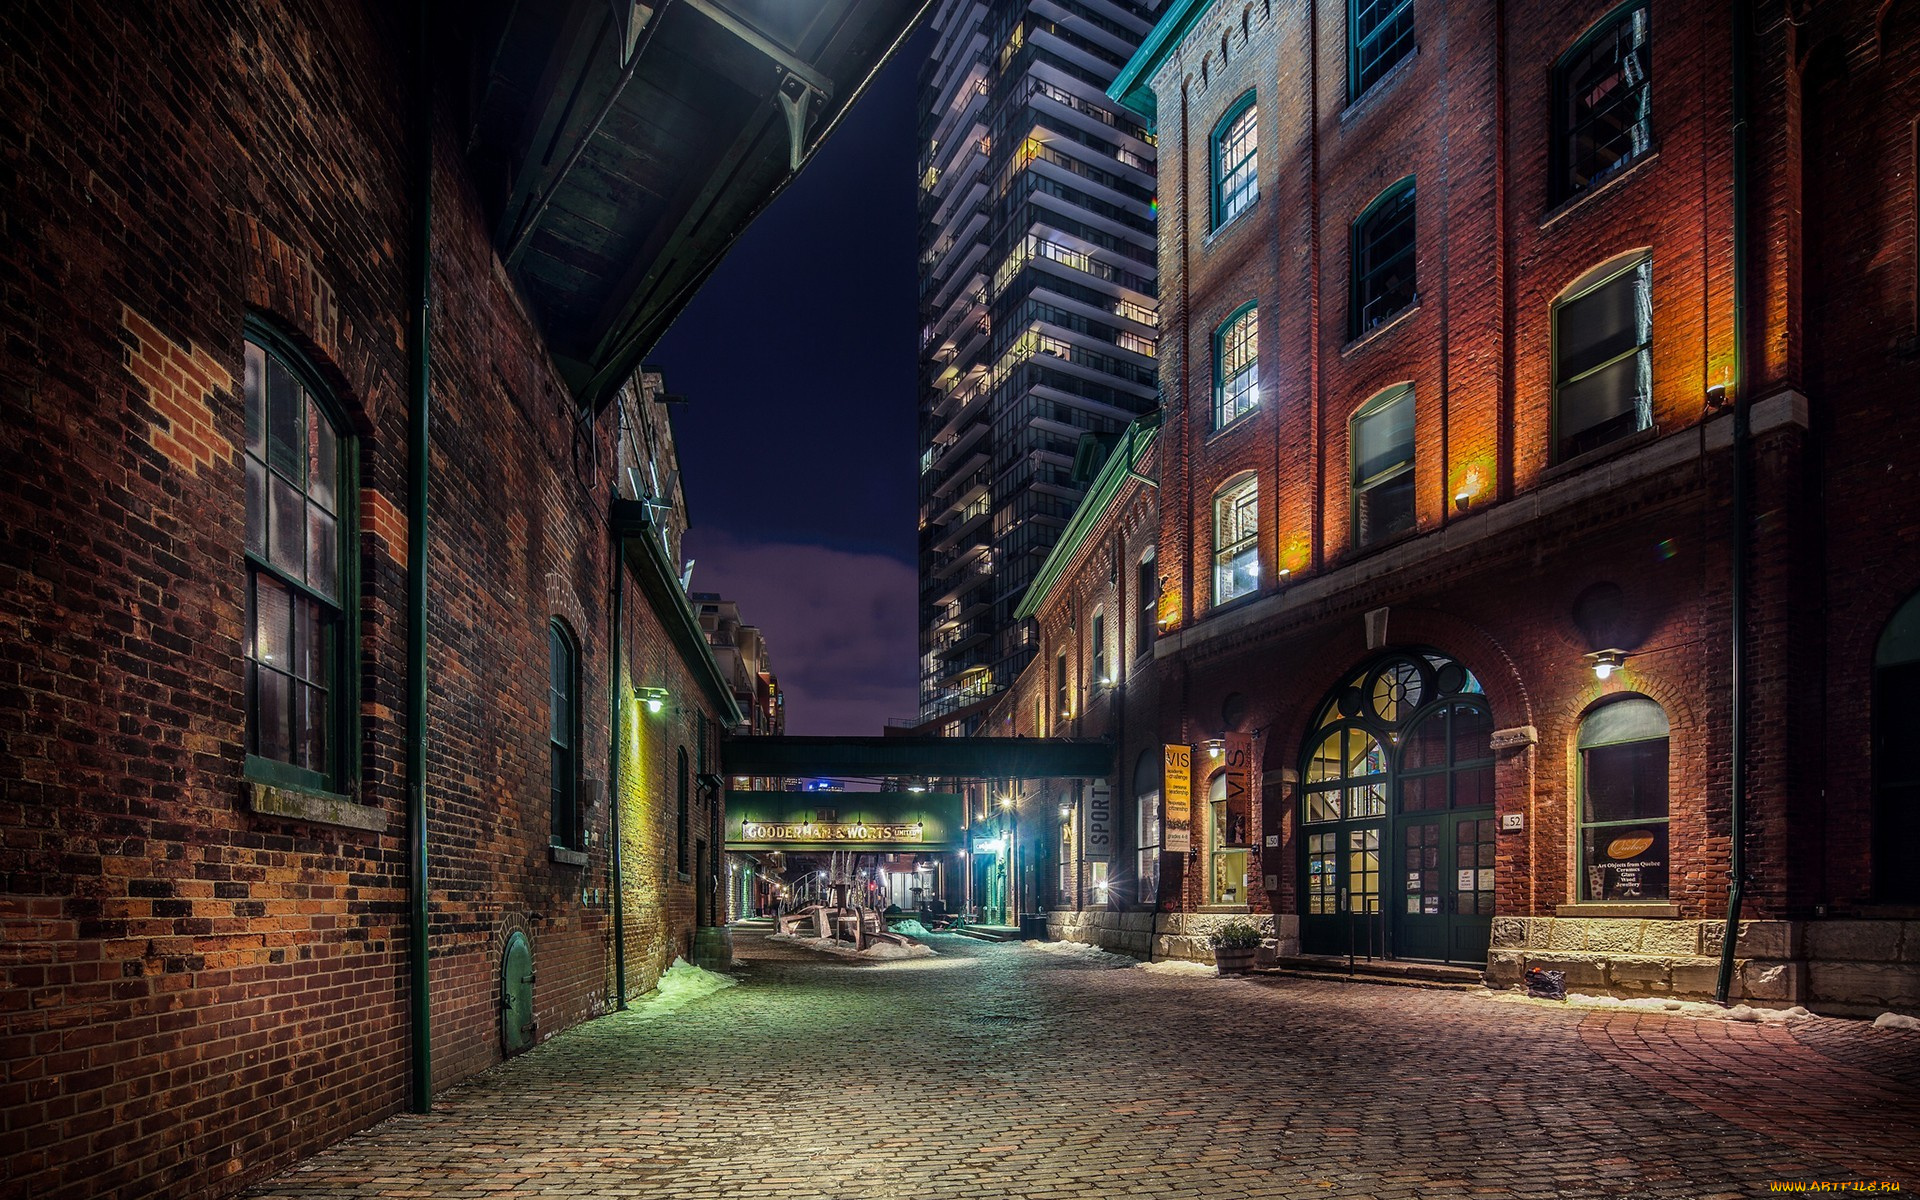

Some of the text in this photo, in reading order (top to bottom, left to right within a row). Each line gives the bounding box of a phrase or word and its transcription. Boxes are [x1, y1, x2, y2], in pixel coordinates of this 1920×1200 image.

[1166, 752, 1190, 767] VIS
[1227, 749, 1245, 798] VIS
[1091, 787, 1110, 845] SPORT
[1510, 816, 1521, 827] 52
[748, 825, 832, 839] GOODERHAM
[836, 826, 846, 839] &
[847, 826, 892, 839] WORTS
